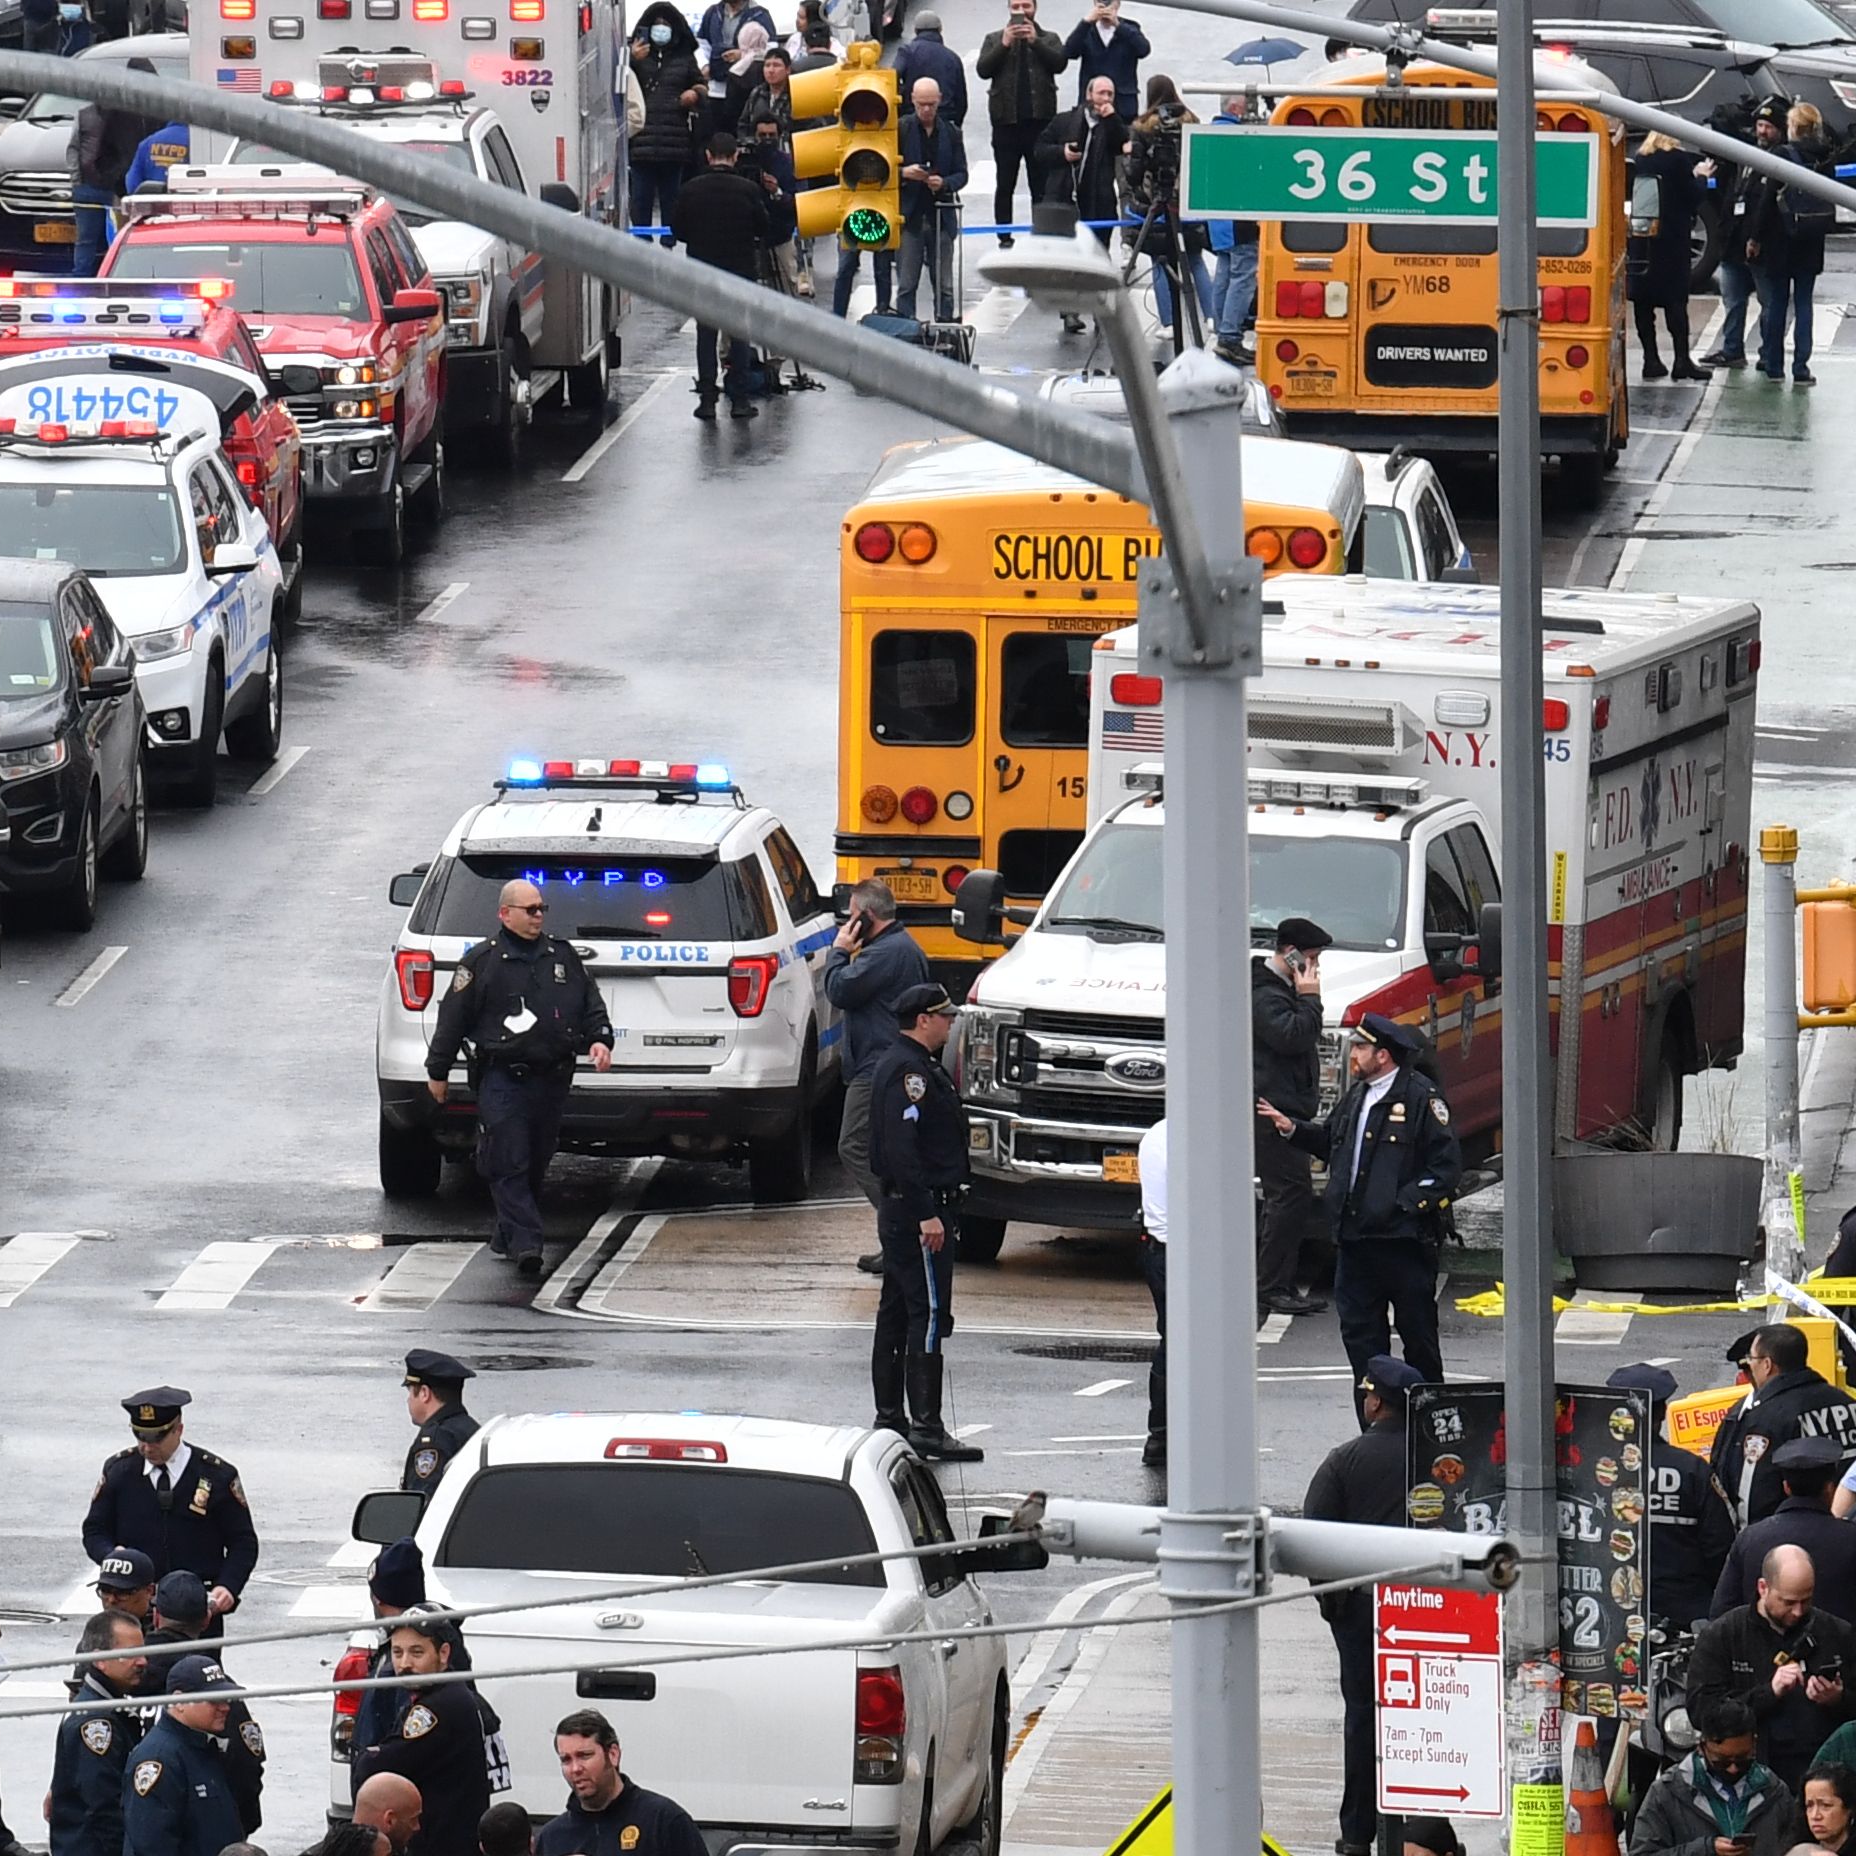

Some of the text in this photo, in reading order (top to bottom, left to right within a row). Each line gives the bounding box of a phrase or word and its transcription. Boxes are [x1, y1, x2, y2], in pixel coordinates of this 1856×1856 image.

[501, 69, 554, 87] 3822
[1290, 149, 1489, 202] 36 St
[1393, 257, 1481, 268] EMERGENCY DOOR
[1402, 274, 1451, 294] YM68
[1377, 346, 1488, 361] DRIVERS WANTED
[993, 534, 1113, 583] SCHOOL
[1047, 618, 1118, 632] EMERGENCY
[1423, 730, 1497, 769] N.Y.
[1604, 759, 1699, 850] F.D. N.Y.
[524, 868, 665, 886] NYPD
[1622, 857, 1673, 903] AMBULANCE
[619, 943, 710, 962] POLICE
[1431, 1406, 1459, 1418] OPEN
[1675, 1411, 1691, 1430] El
[1433, 1414, 1464, 1436] 24
[1383, 1586, 1445, 1611] Anytime
[1424, 1661, 1457, 1678] Truck
[1424, 1679, 1471, 1702] Loading
[1424, 1697, 1453, 1715] Only
[1385, 1725, 1409, 1742] 7am
[1419, 1727, 1445, 1747] 7pm
[1385, 1746, 1470, 1770] Except Sunday
